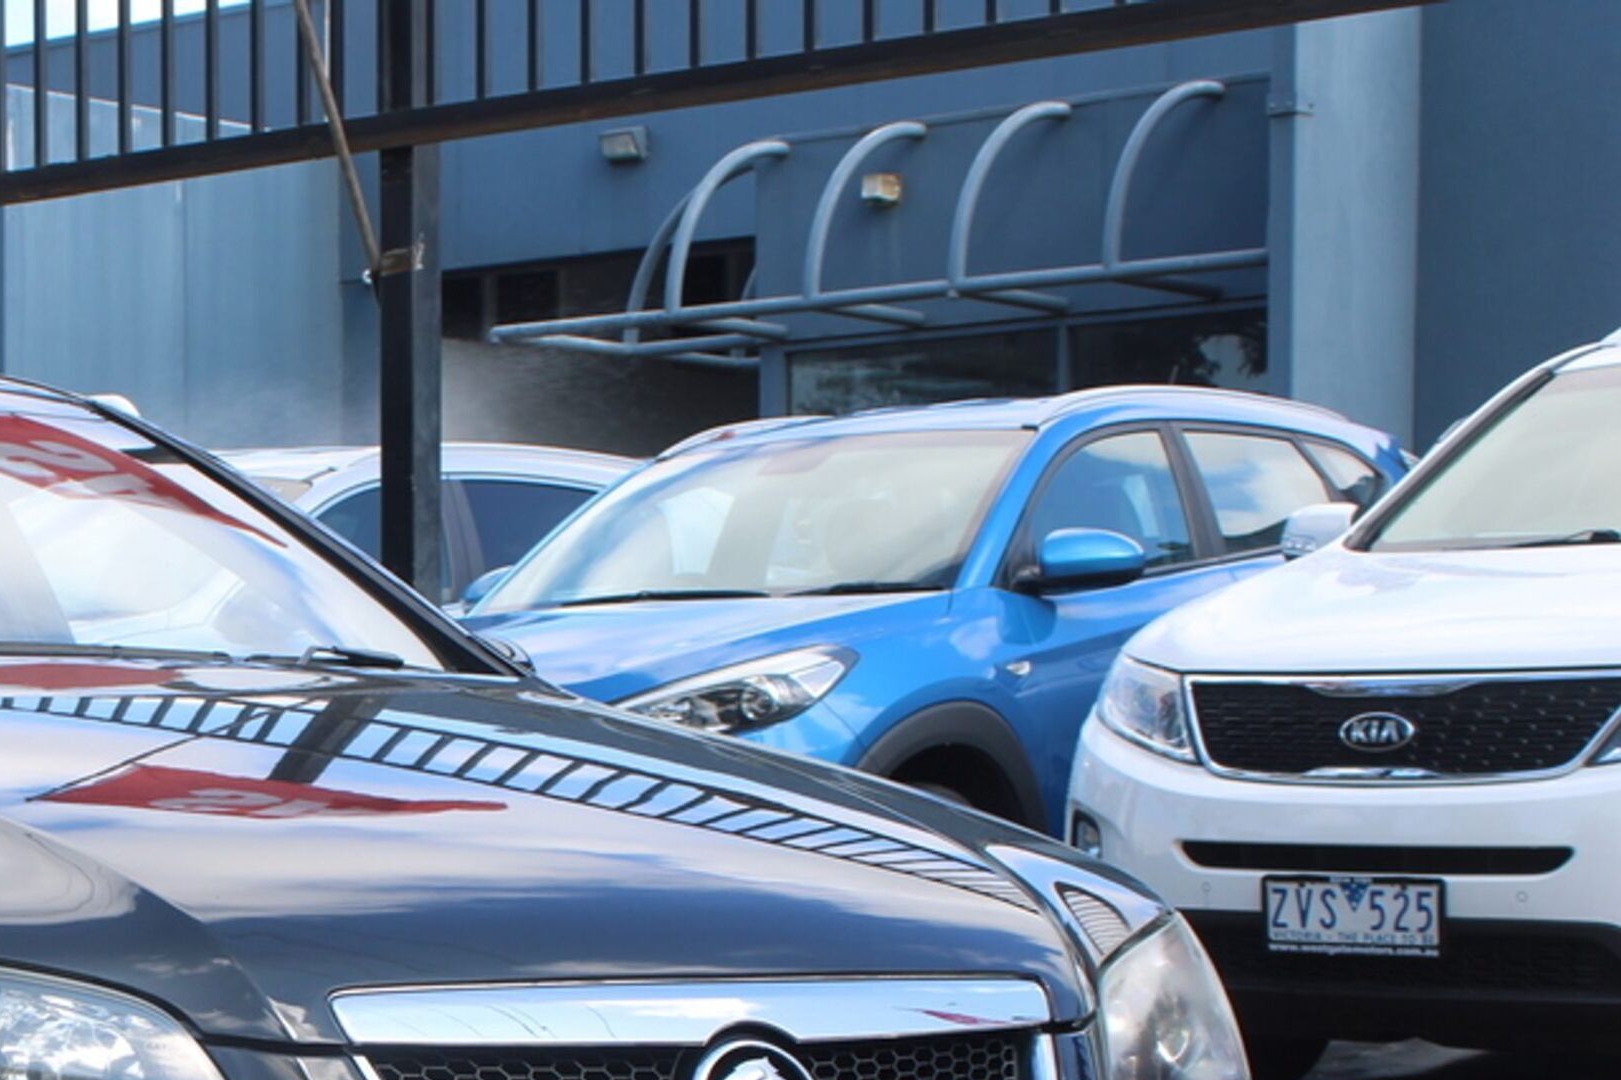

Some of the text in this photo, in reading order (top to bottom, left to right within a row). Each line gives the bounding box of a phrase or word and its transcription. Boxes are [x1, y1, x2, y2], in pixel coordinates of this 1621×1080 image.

[1350, 720, 1399, 743] KIA
[1271, 888, 1433, 933] ZVS 525
